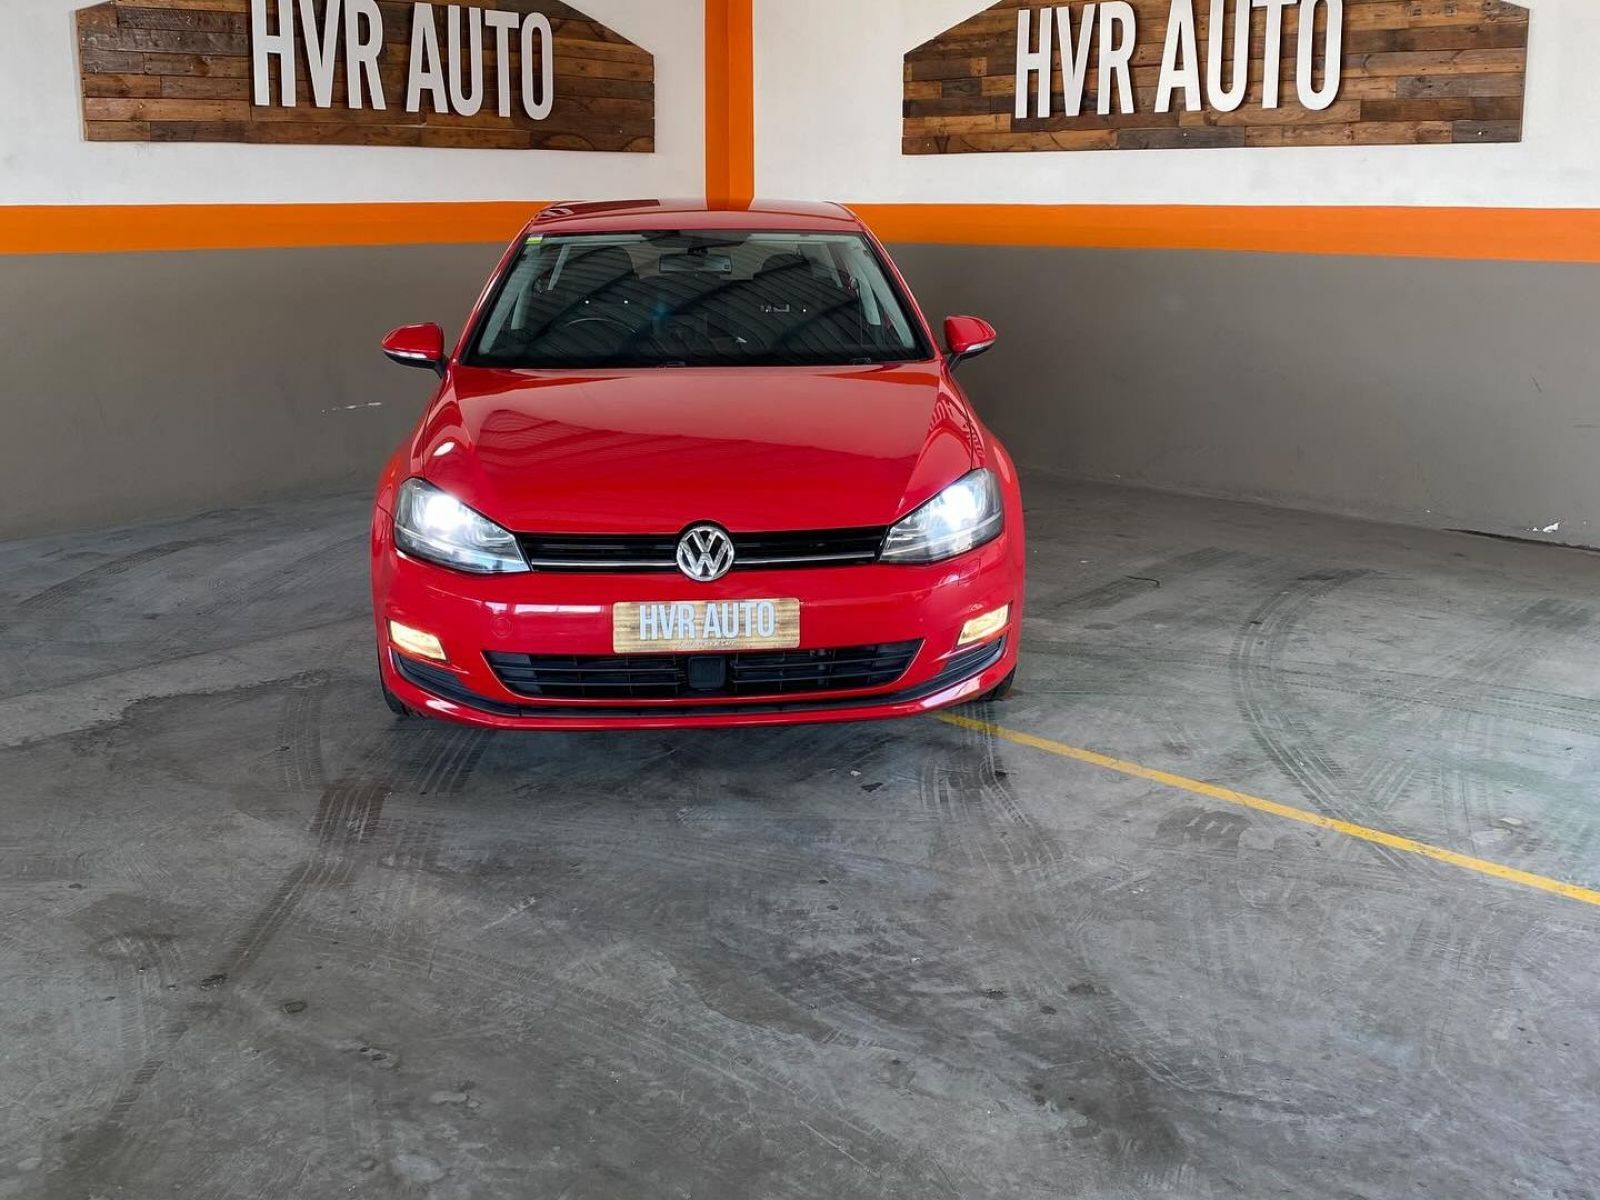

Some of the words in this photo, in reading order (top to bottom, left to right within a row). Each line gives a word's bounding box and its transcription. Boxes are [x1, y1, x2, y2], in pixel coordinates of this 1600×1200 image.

[250, 0, 387, 110] HVR
[405, 2, 554, 120] AUTO
[1014, 0, 1136, 119] HVR
[1154, 0, 1342, 113] AUTO
[639, 602, 696, 641] HVR
[702, 601, 776, 639] AUTO
